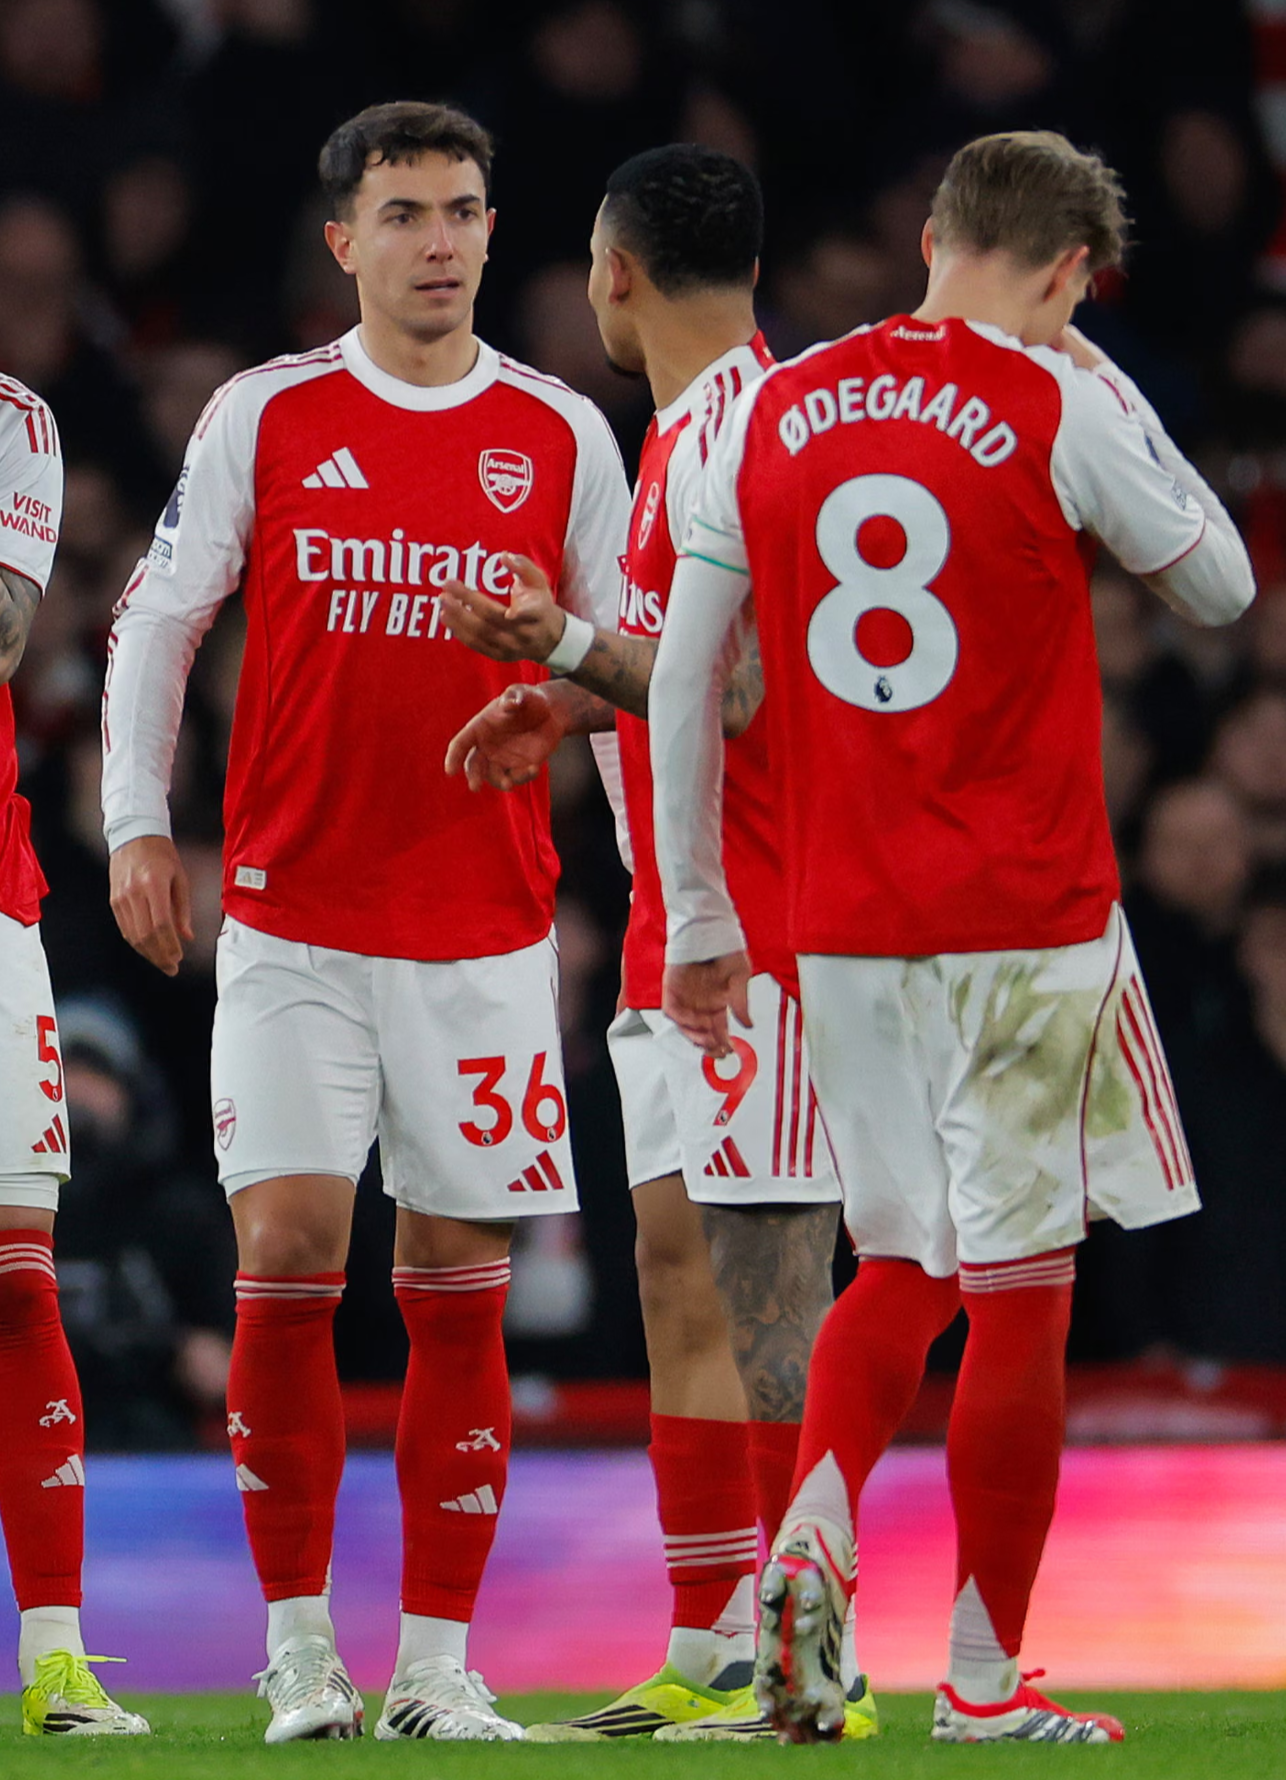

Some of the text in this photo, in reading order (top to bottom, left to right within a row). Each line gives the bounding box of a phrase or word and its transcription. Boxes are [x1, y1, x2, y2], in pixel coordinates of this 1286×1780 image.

[778, 373, 1018, 468] ØDEGAARD
[13, 491, 52, 523] VISIT
[487, 457, 525, 474] Arsenal
[293, 527, 513, 595] Emirate
[806, 472, 960, 713] 8
[327, 589, 379, 634] FLY
[36, 1014, 63, 1103] 5
[457, 1050, 566, 1147] 36
[701, 1035, 758, 1127] 9
